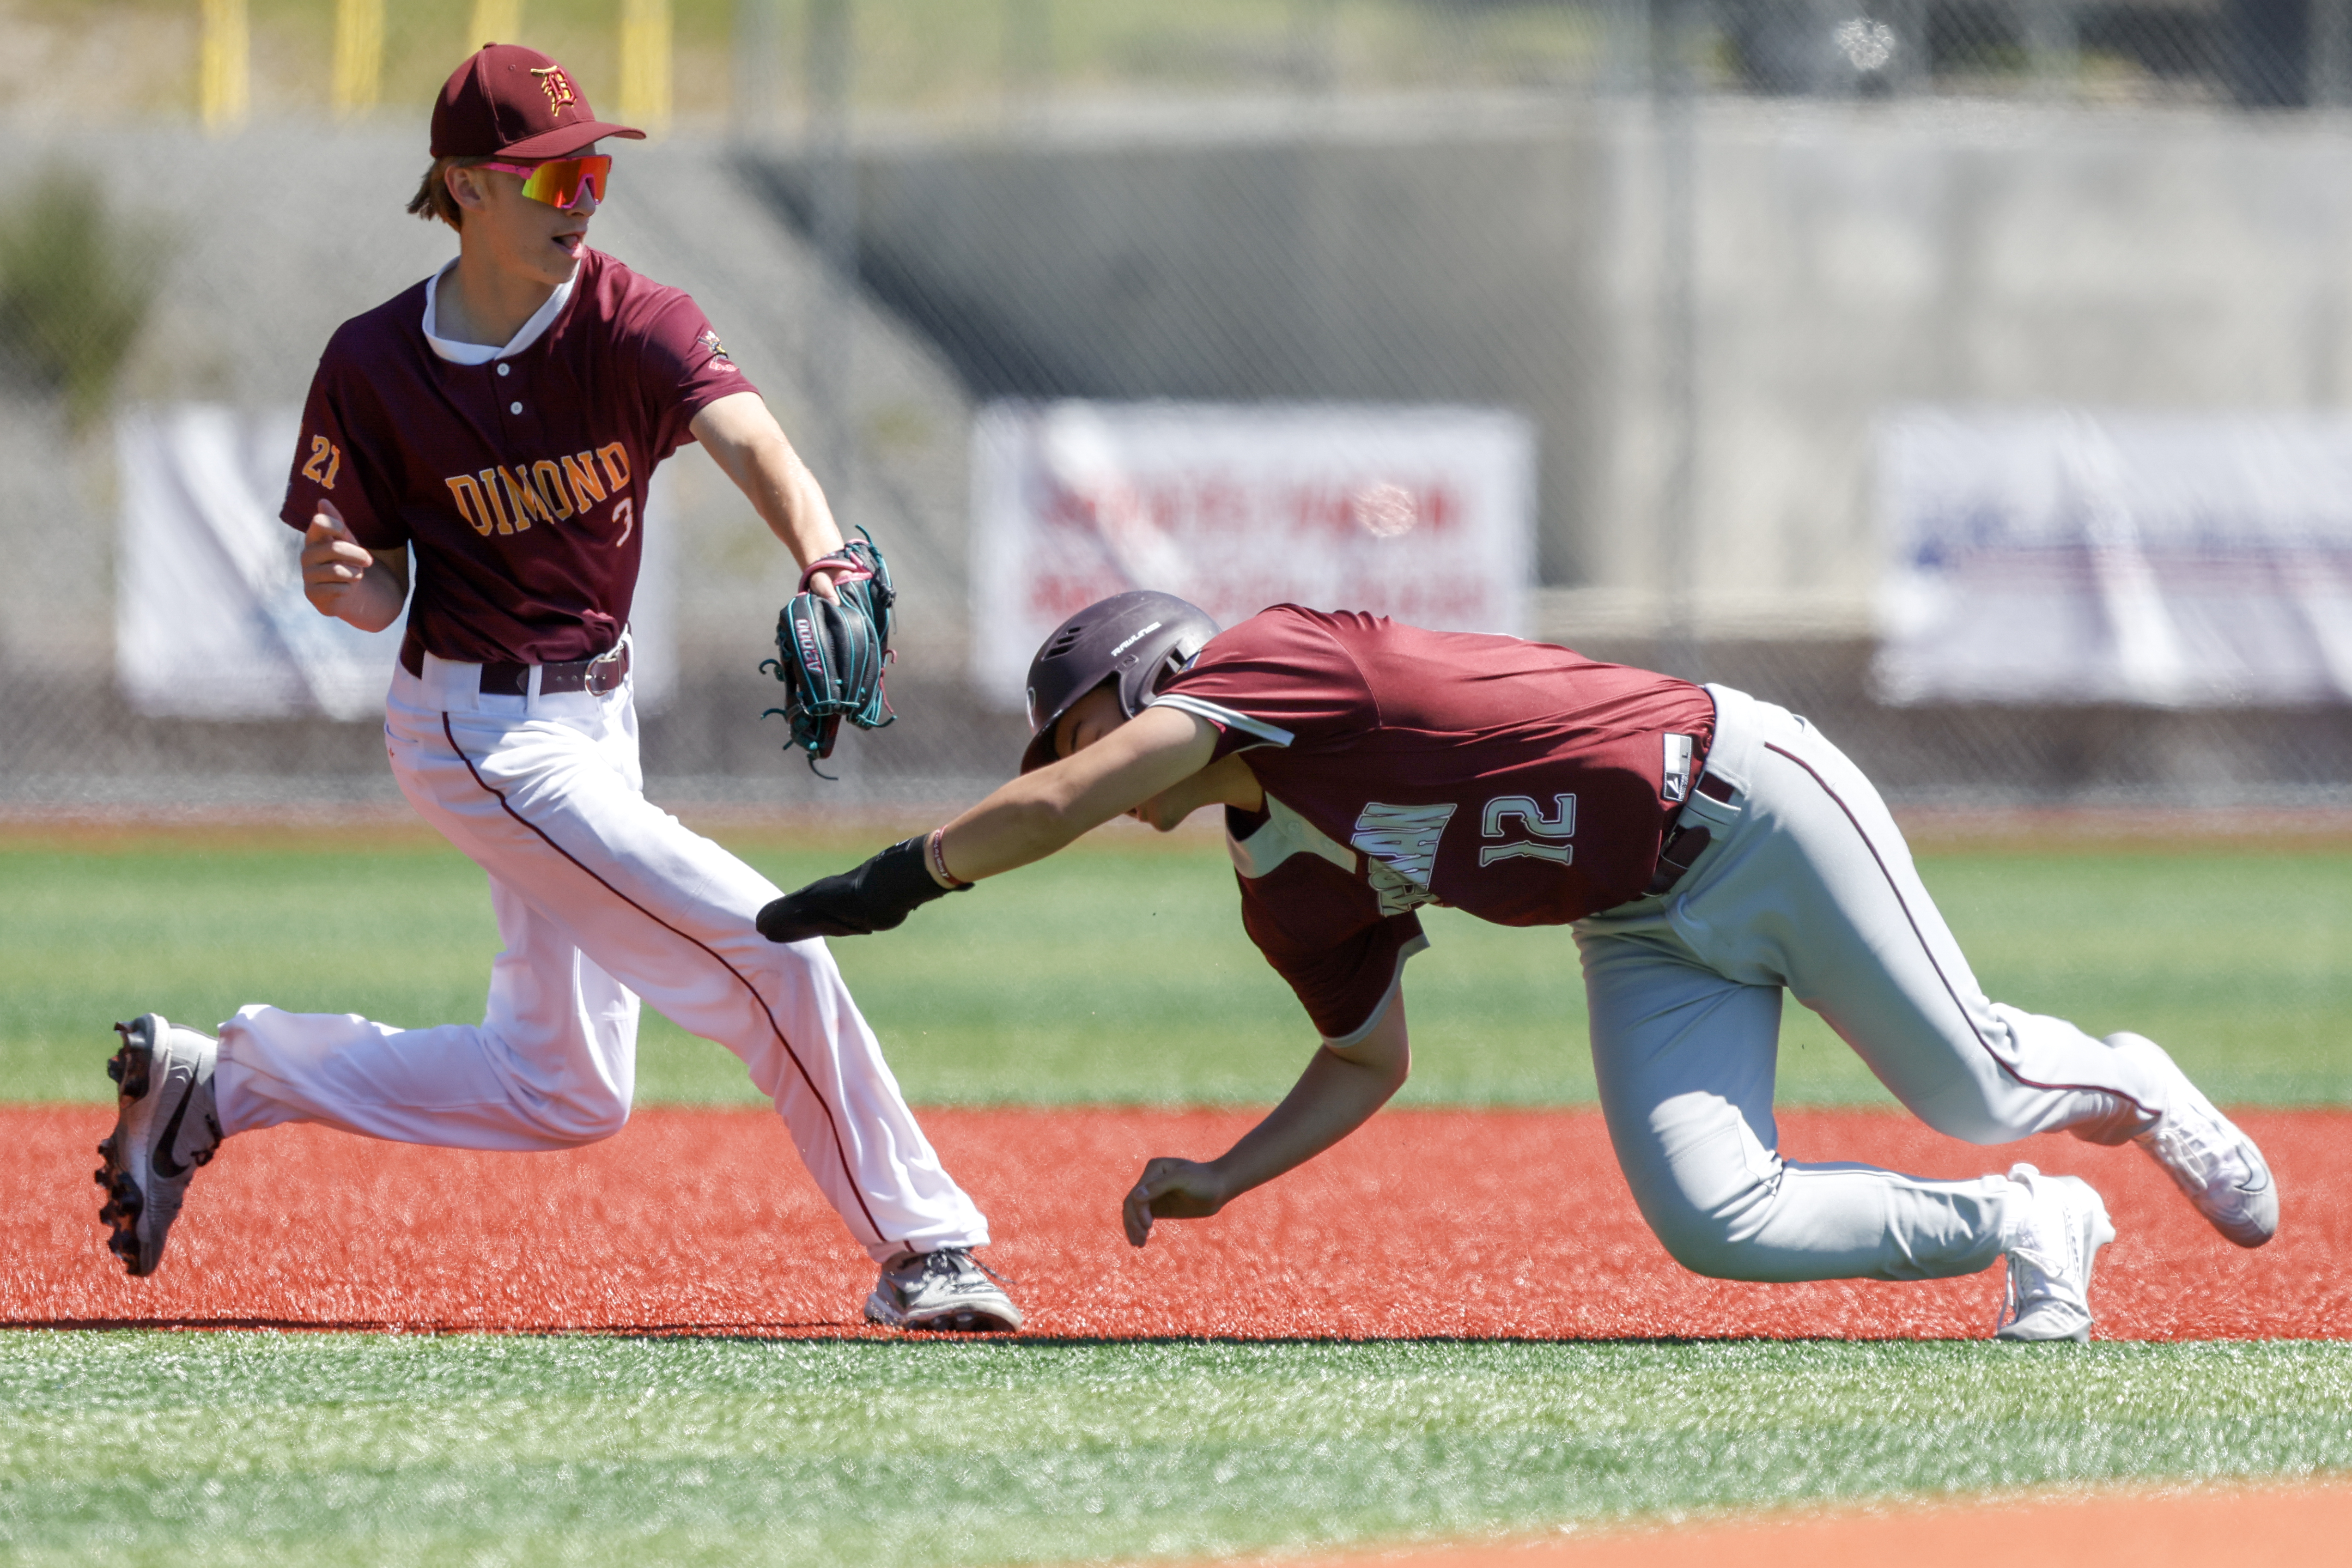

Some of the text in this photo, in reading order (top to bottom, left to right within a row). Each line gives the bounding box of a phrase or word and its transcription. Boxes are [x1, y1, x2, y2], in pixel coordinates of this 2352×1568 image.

[302, 434, 341, 490] 21
[445, 441, 632, 536] DIMOND
[795, 618, 824, 675] A2000
[1480, 793, 1576, 867] 12
